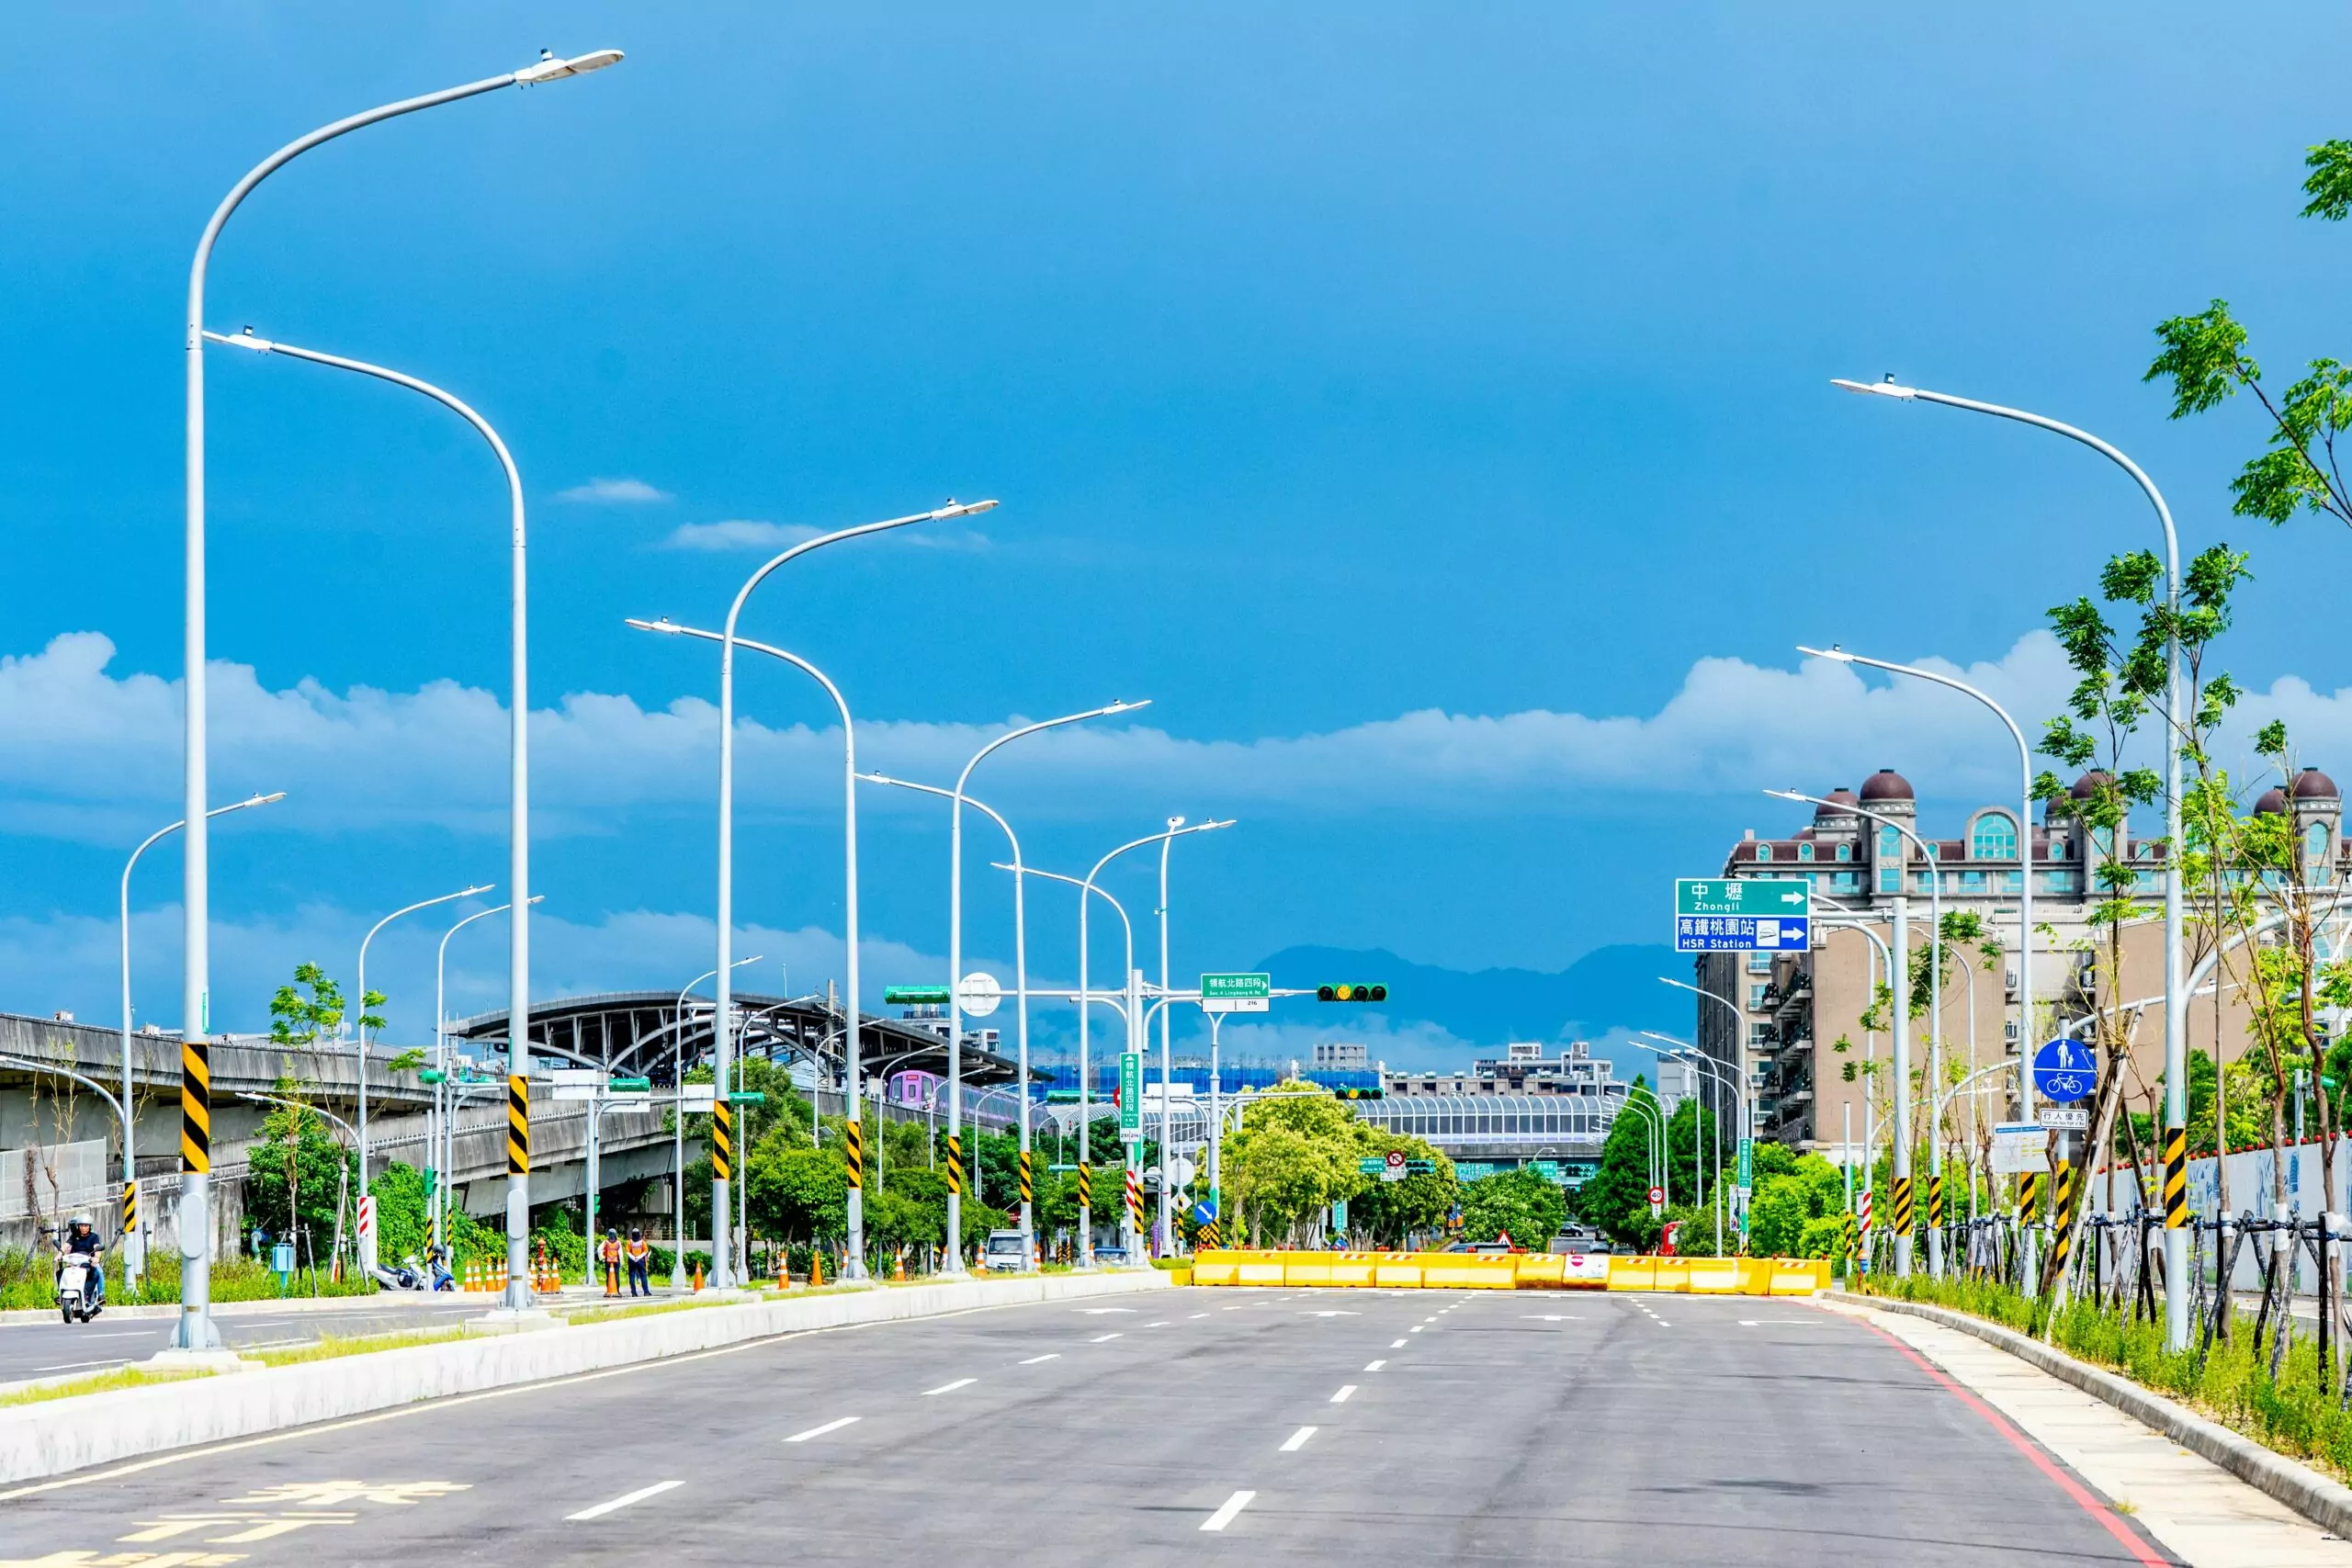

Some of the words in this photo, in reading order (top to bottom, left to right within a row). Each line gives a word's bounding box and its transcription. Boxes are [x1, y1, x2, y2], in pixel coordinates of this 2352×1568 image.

[1691, 882, 1743, 901] 中壢
[1694, 901, 1739, 913] Zhongli
[1679, 919, 1755, 936] 高鐵桃園站
[1682, 939, 1705, 948] HSR
[1710, 938, 1752, 948] Station
[1209, 977, 1261, 988] 領航北路四段
[2043, 1111, 2085, 1122] 行人優先
